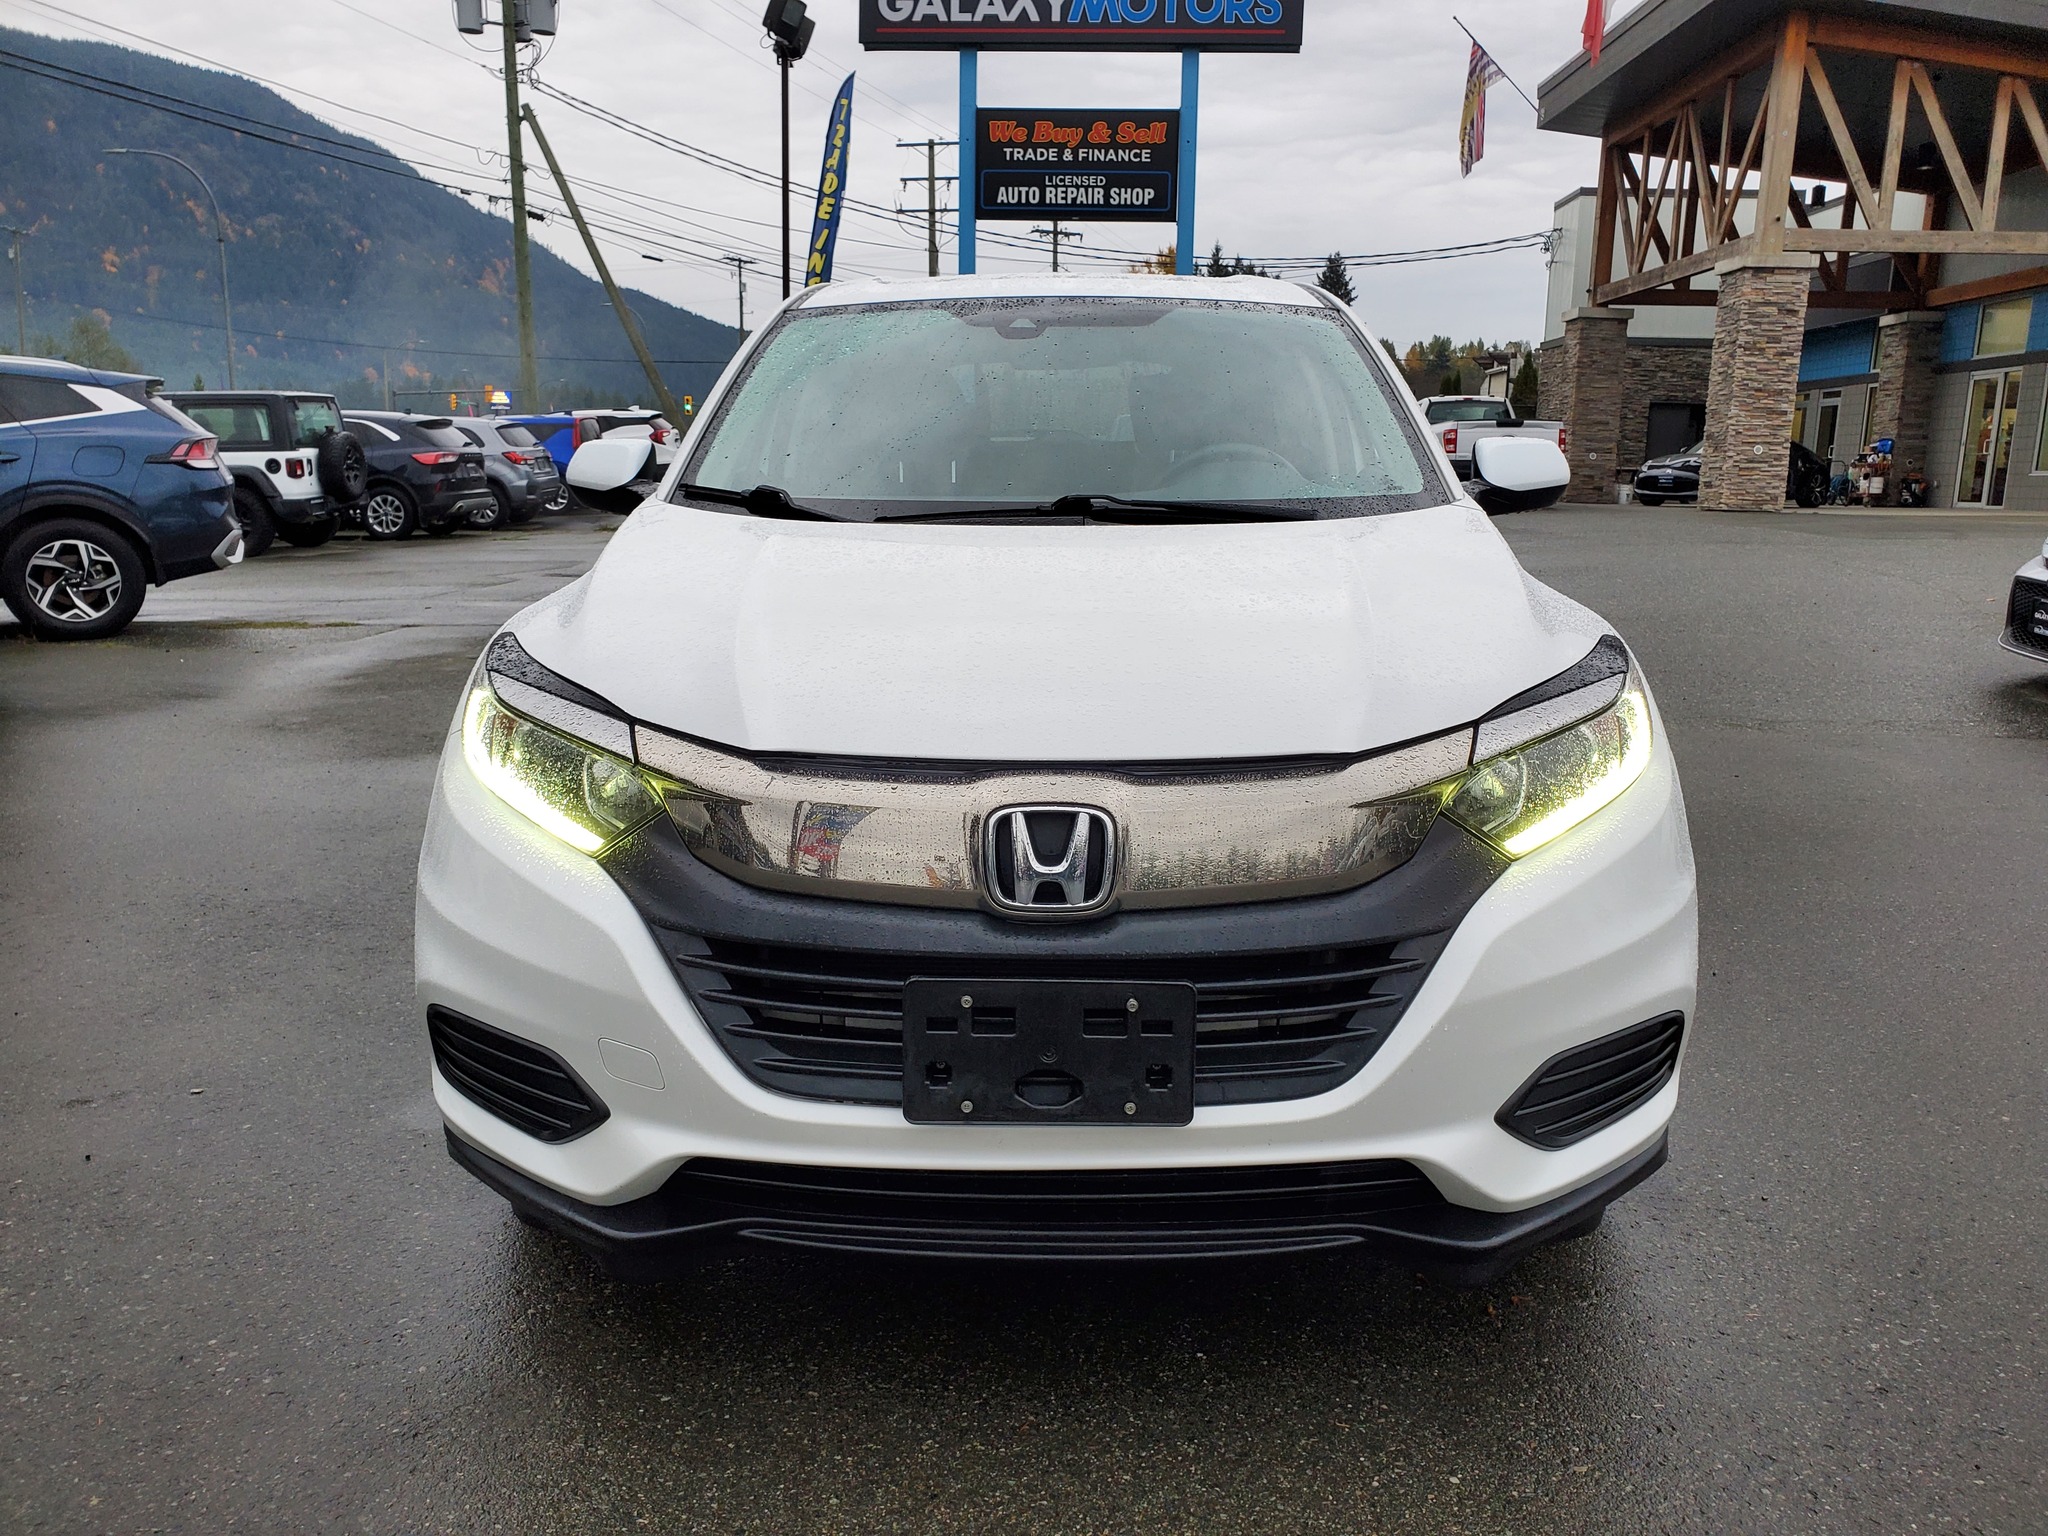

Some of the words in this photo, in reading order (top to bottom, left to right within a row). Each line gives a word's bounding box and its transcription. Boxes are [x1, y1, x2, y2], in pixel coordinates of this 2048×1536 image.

[989, 121, 1028, 142] We
[1032, 121, 1083, 148] Buy
[1088, 121, 1112, 143] &
[1116, 122, 1167, 144] Sell
[1003, 148, 1058, 161] TRADE
[1063, 148, 1074, 161] &
[1078, 149, 1152, 162] FINANCE
[1045, 175, 1106, 186] LICENSED
[997, 186, 1040, 204] AUTO
[1046, 187, 1104, 205] REPAIR
[1109, 188, 1155, 205] SHOP
